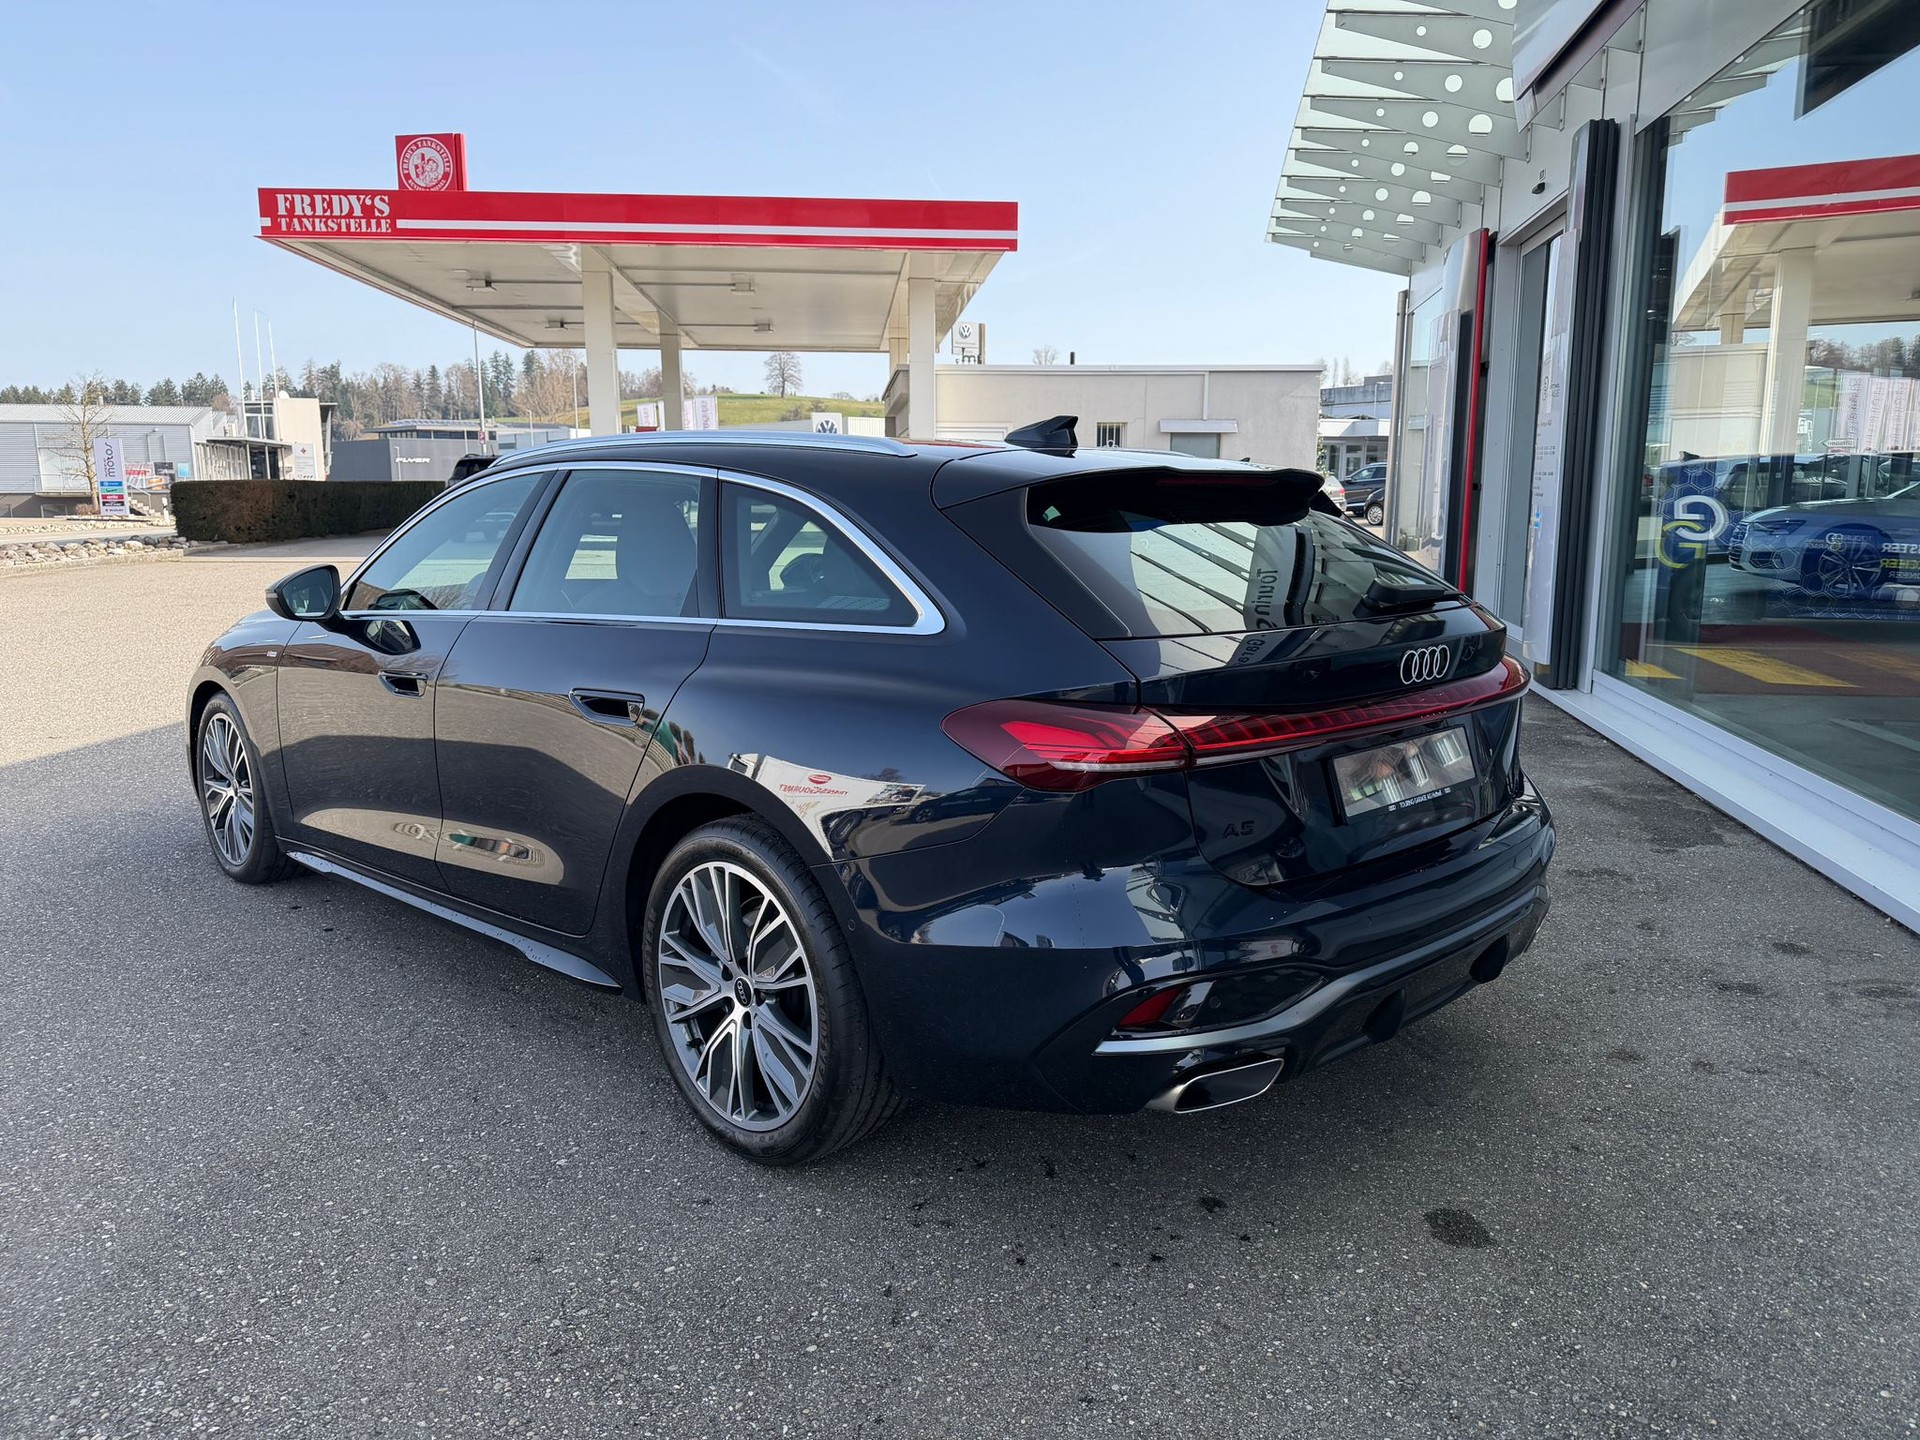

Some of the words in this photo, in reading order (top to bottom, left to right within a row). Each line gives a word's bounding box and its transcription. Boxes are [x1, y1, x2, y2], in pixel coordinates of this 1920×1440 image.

[416, 140, 450, 173] TANKSTELLE
[275, 193, 391, 217] FREDY'S
[278, 217, 391, 233] TANKSTELLE
[1223, 820, 1255, 839] A5
